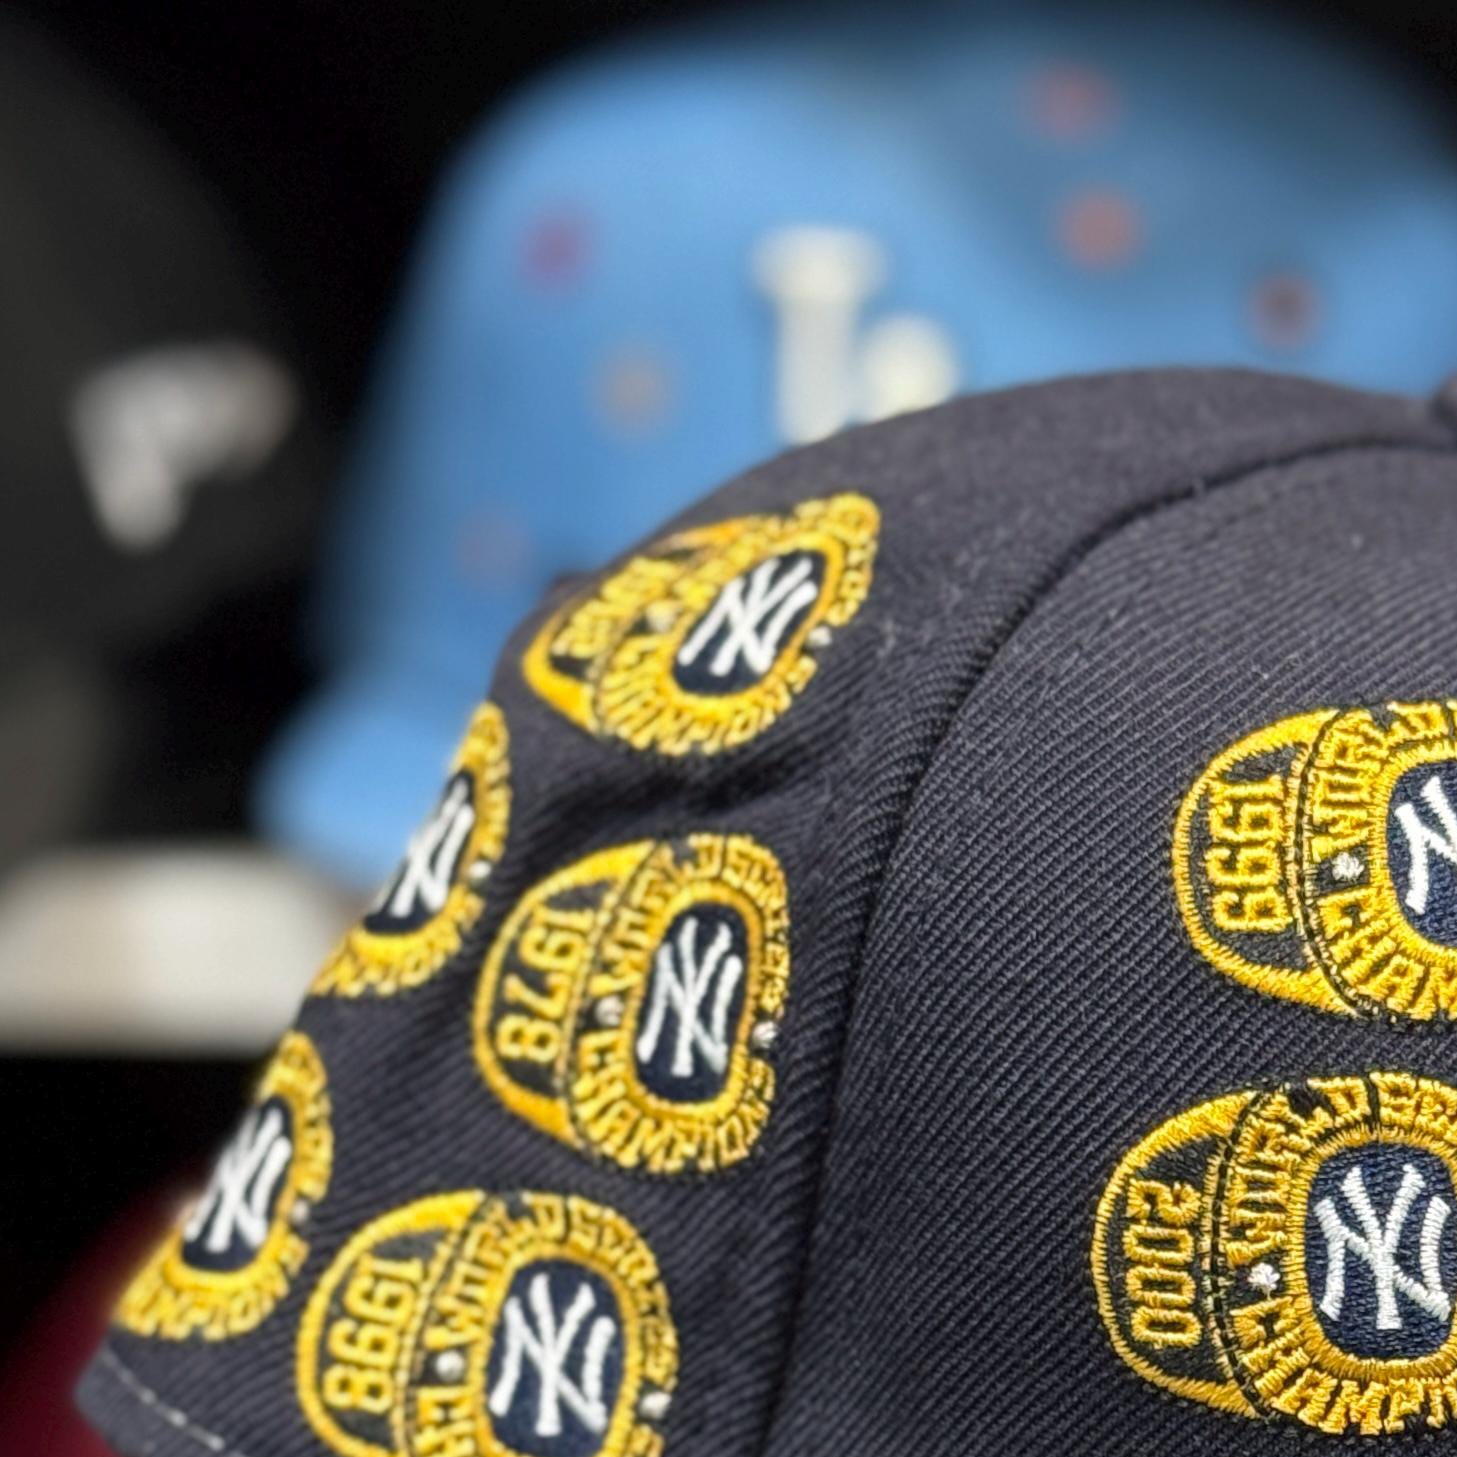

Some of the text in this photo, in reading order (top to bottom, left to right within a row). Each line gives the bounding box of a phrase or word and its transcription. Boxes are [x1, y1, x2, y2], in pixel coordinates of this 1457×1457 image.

[676, 557, 818, 677] NY
[1206, 776, 1292, 932] 1999
[496, 905, 595, 1063] 1978
[637, 916, 743, 1077] NY
[1122, 1179, 1202, 1349] 2000
[1313, 1163, 1451, 1330] NY
[323, 1256, 425, 1414] 1998
[488, 1273, 615, 1437] NY
